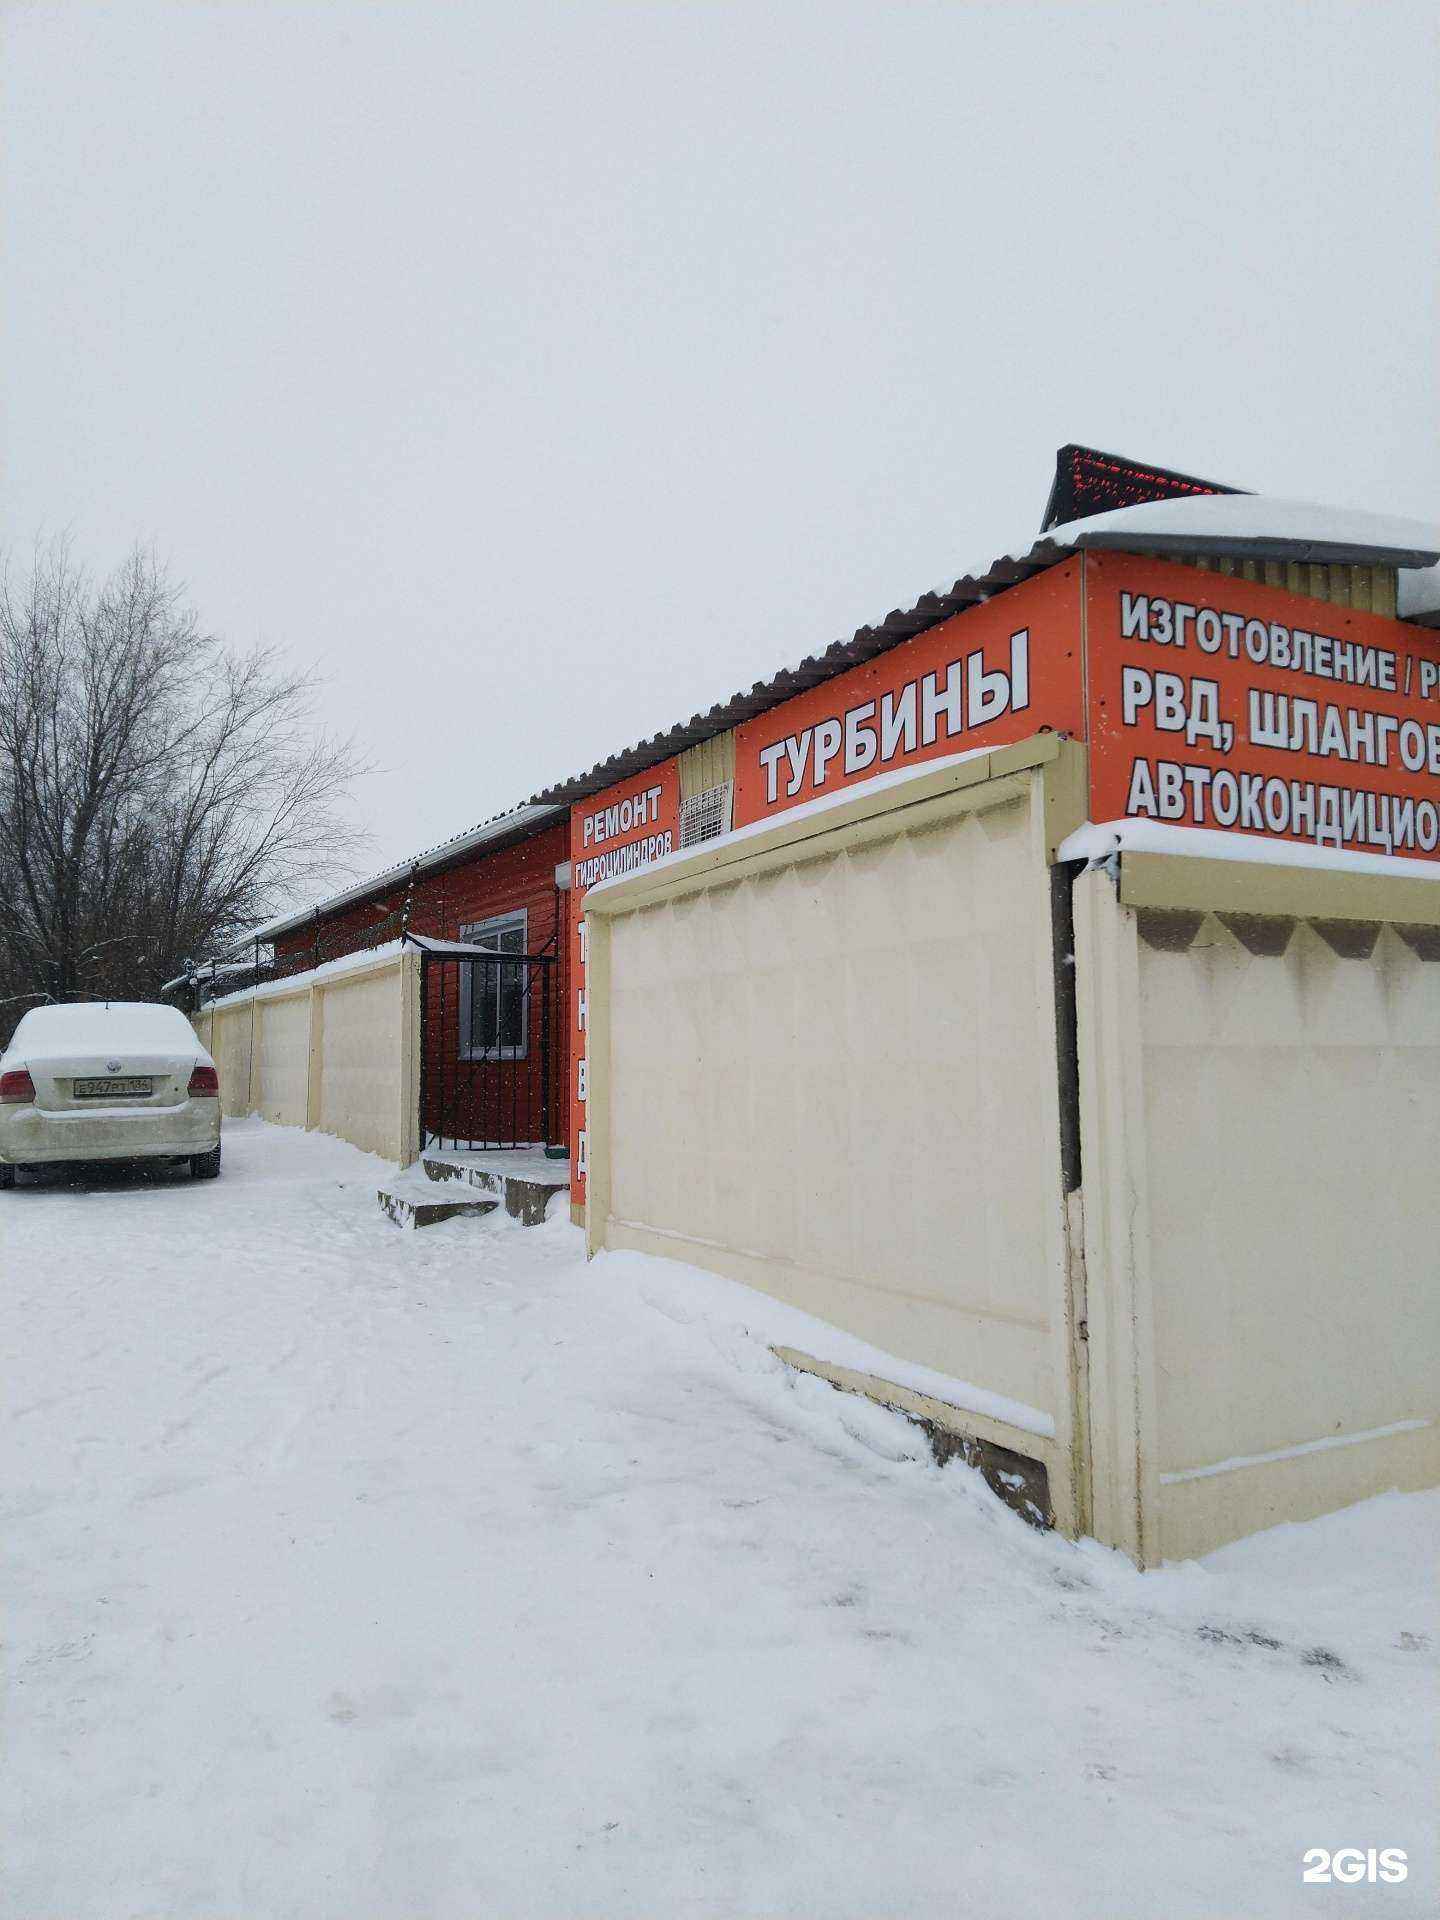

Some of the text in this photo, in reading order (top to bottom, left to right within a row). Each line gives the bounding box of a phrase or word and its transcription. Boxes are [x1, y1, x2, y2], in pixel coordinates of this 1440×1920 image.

[1119, 591, 1397, 692] ИЗГОТОВЛЕНИЕ
[1420, 658, 1440, 699] Р
[760, 627, 1030, 803] ТУРБИНЫ
[1121, 665, 1234, 754] РВД,
[583, 784, 662, 848] РЕМОНТ
[1125, 757, 1440, 855] АВТОКОНДИЦИО
[575, 830, 673, 889] ГИДРОЦИЛИНДРОВ
